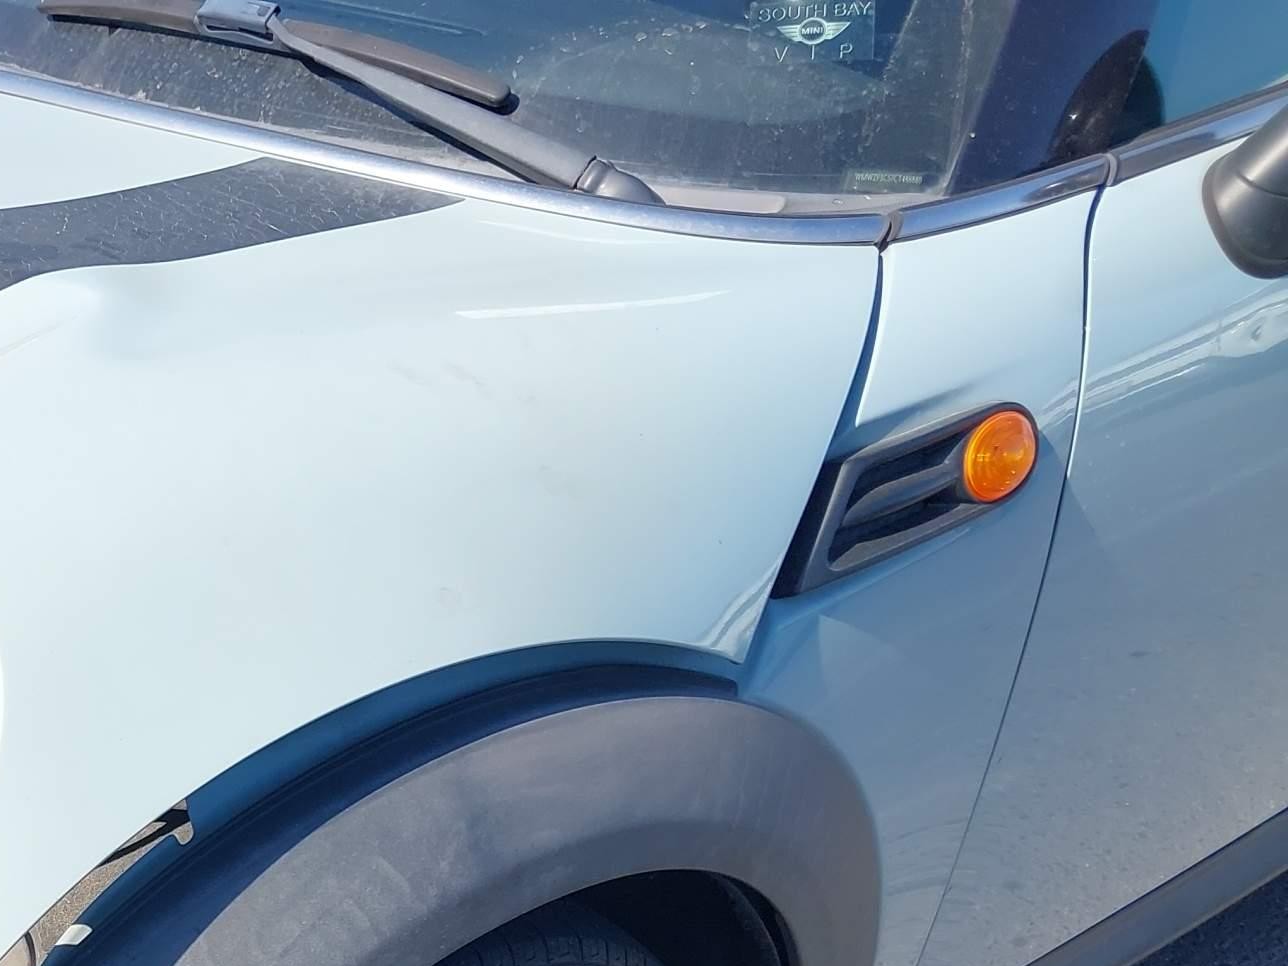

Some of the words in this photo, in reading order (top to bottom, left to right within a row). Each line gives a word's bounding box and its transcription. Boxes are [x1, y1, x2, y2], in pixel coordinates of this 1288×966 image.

[758, 3, 827, 23] SOUTH
[834, 1, 872, 17] BAY
[801, 26, 824, 36] MINI
